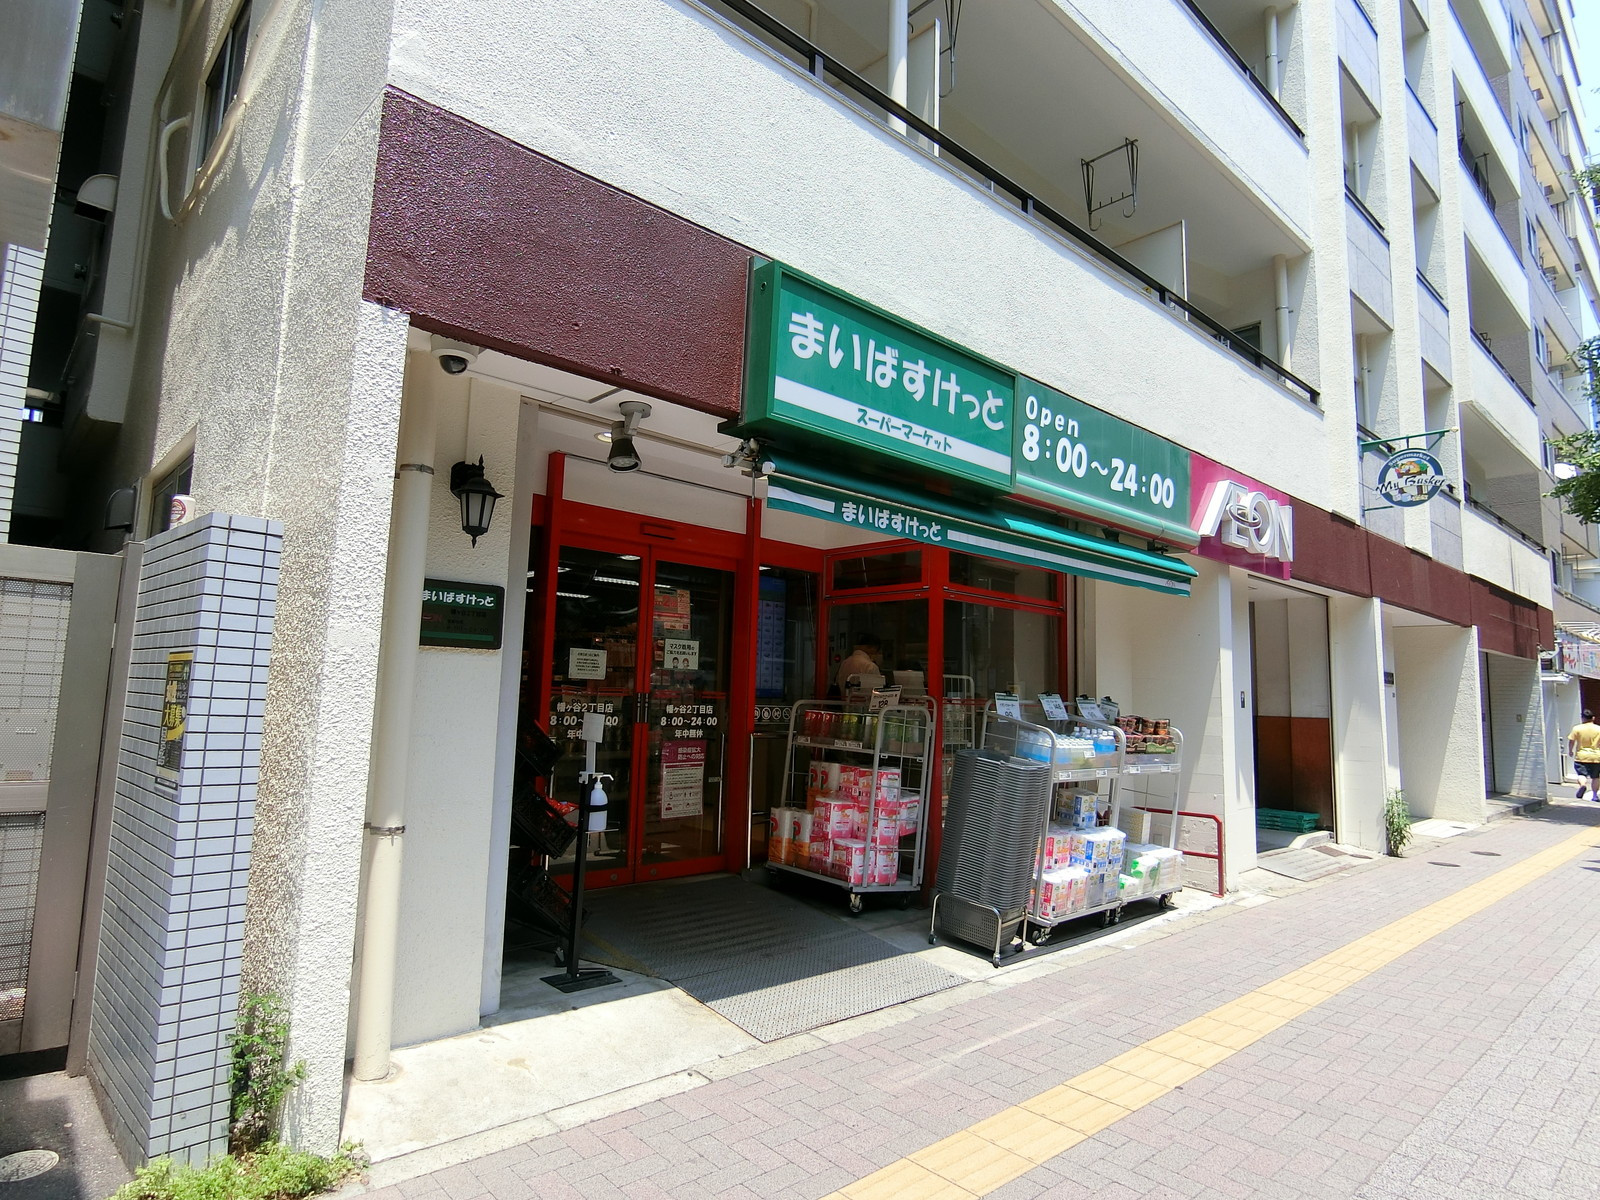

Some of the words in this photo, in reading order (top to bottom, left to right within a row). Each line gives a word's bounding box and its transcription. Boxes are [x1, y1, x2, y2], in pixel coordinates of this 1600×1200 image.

[788, 311, 1006, 431] まいばすけっと
[855, 406, 953, 453] スーパーマーケット
[1024, 395, 1080, 438] Open
[840, 500, 943, 542] まいばすけっと
[1200, 478, 1295, 563] AEON
[422, 590, 494, 606] まいばすけっと
